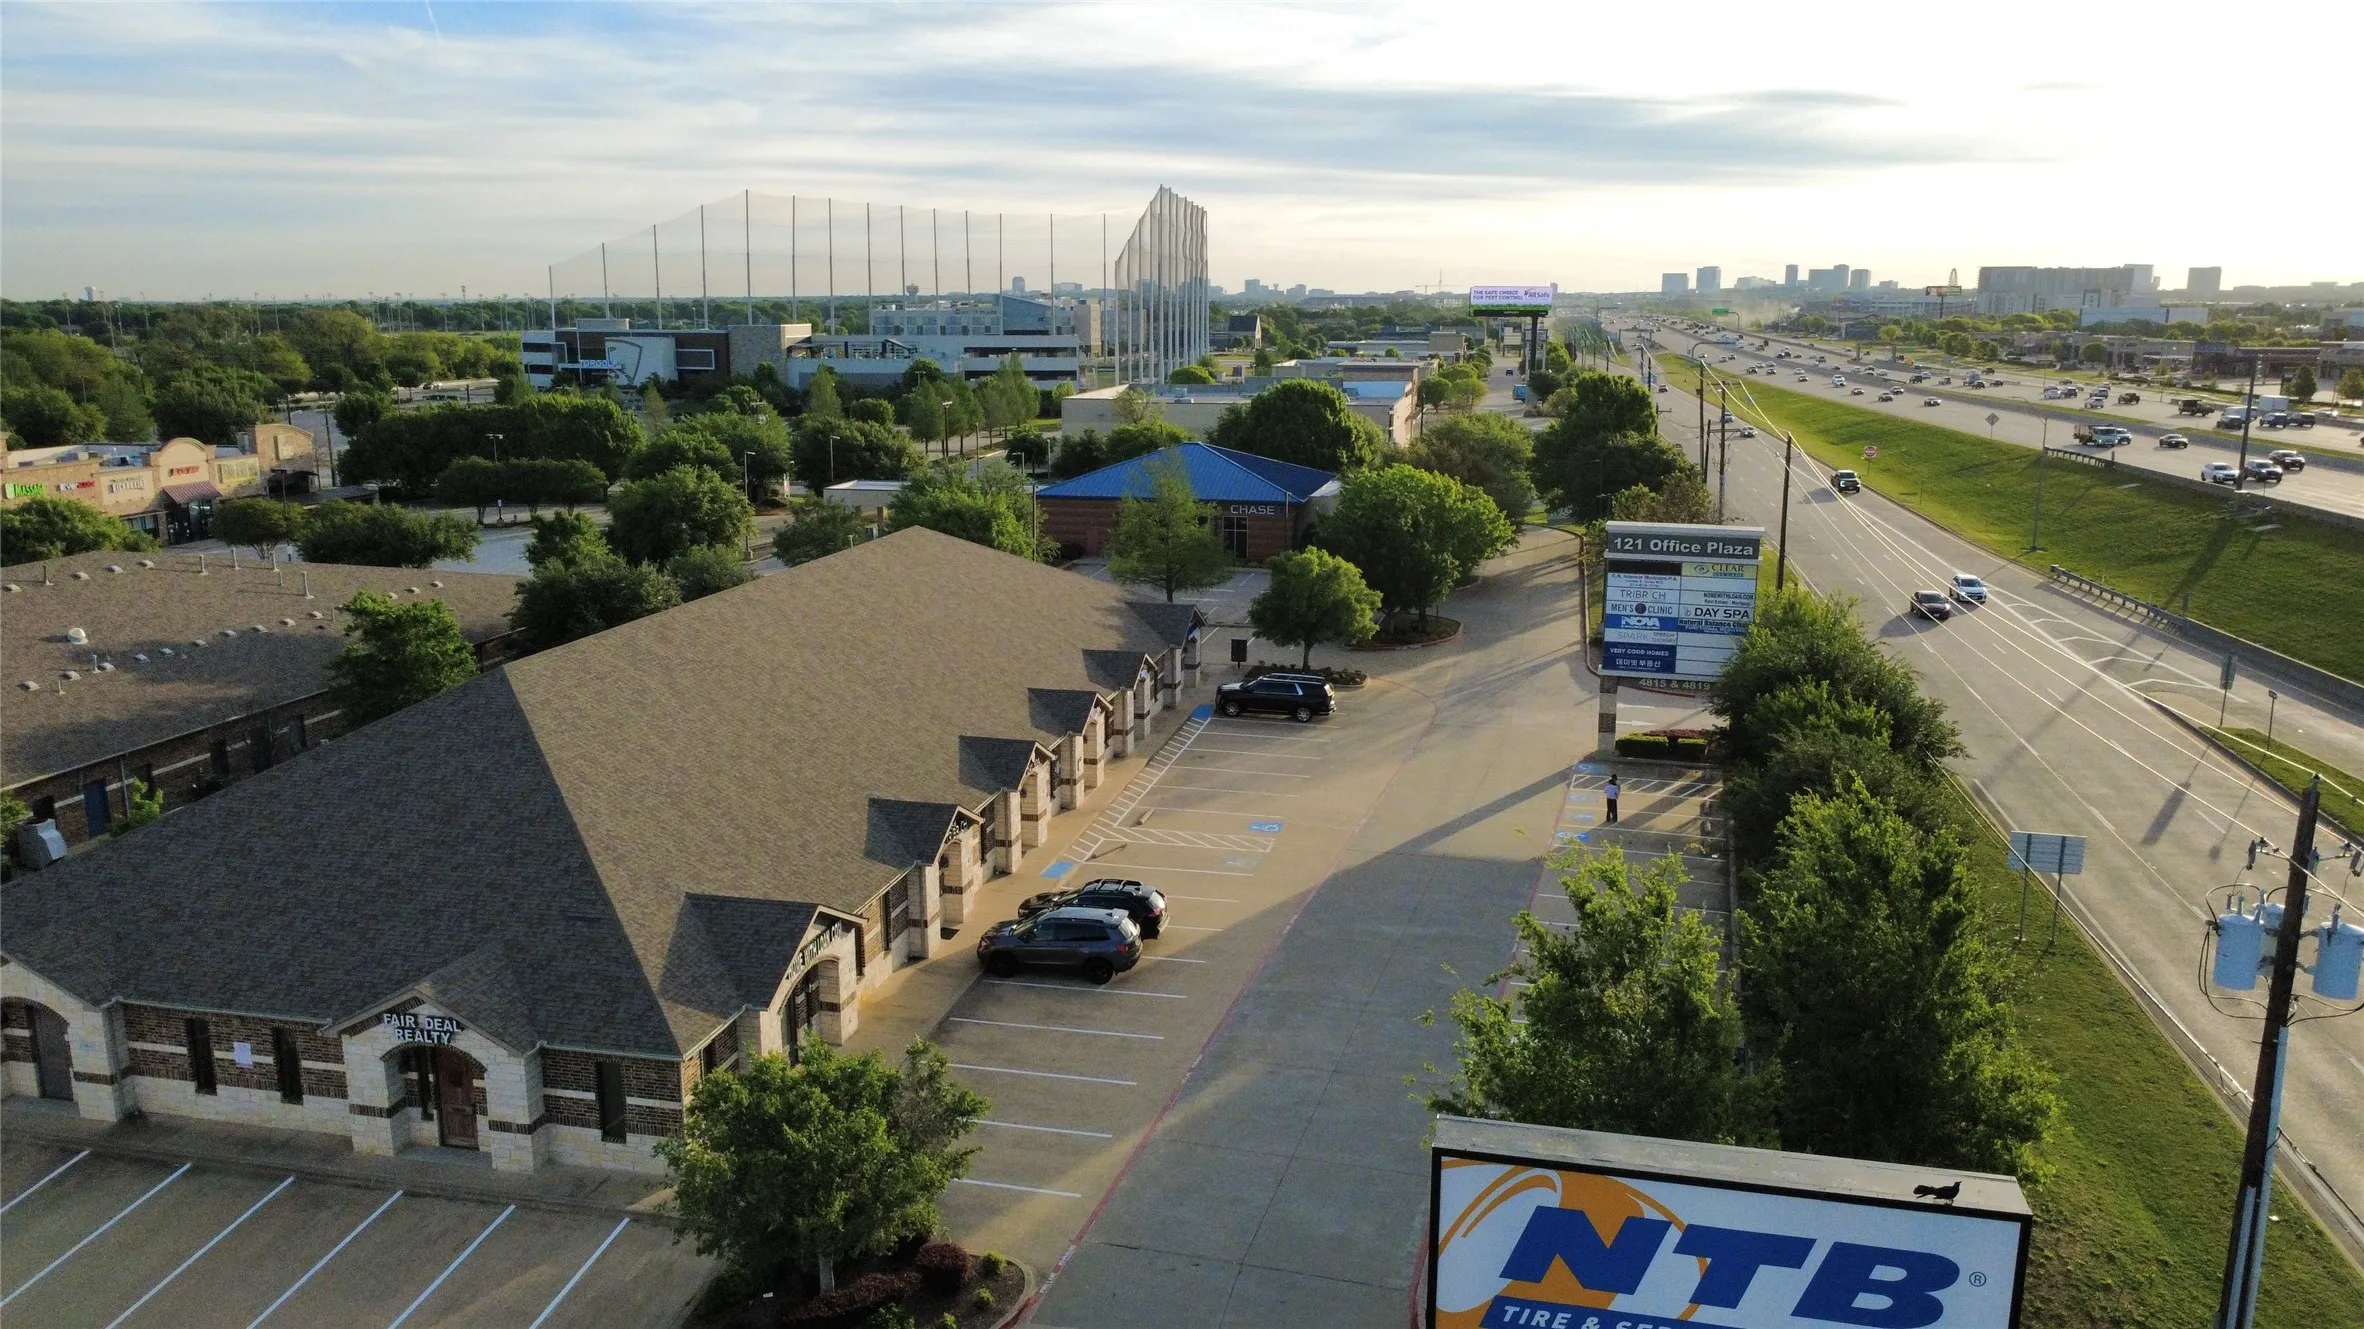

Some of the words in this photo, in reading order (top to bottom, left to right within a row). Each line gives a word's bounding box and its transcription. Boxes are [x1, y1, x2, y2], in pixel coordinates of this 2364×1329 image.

[1230, 504, 1274, 515] CHASE
[1614, 538, 1643, 550] 121
[1650, 539, 1701, 553] Office
[1707, 542, 1754, 556] Plaza
[1711, 564, 1744, 572] CLEAR
[1611, 604, 1634, 613] MEN'S
[1648, 605, 1673, 615] CLINIC
[1694, 608, 1720, 618] DAY
[1723, 609, 1750, 619] SPA
[1639, 679, 1667, 688] 4815
[1670, 680, 1679, 688] &
[1682, 681, 1711, 690] 4819
[384, 1013, 416, 1028] FAIR
[424, 1017, 462, 1032] DEAL
[394, 1028, 451, 1045] REALTY
[1498, 1204, 1961, 1329] NTB
[1502, 1306, 1572, 1329] TIRE
